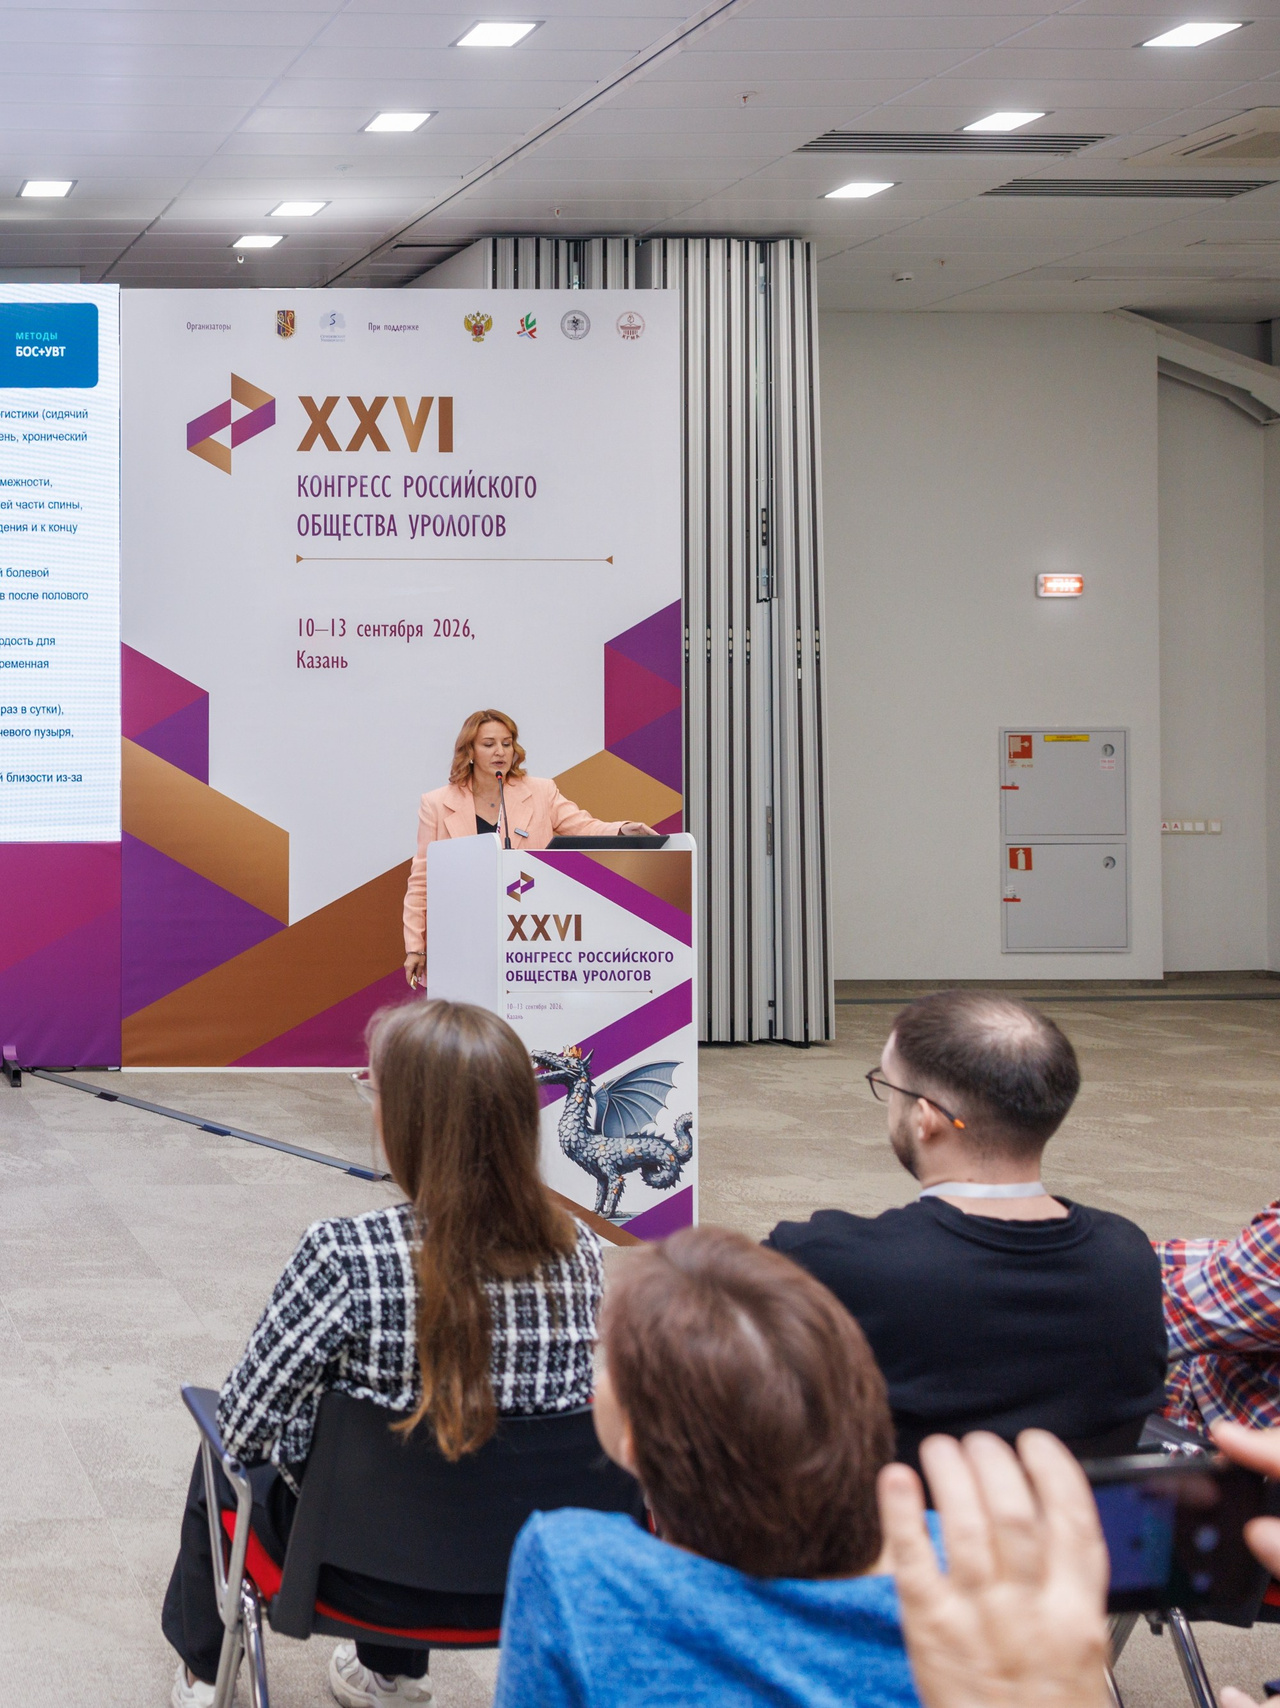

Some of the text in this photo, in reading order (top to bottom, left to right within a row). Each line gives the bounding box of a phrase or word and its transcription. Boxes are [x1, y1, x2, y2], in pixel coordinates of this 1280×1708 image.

[16, 332, 58, 342] МЕТОДЫ
[16, 346, 66, 357] БОС+УВТ
[42, 409, 88, 421] (сидячий
[296, 396, 453, 453] XXVI
[22, 431, 88, 444] хронический
[298, 469, 537, 498] КОНГРЕСС РОССИЙСКОГО
[15, 501, 45, 510] части
[47, 501, 83, 510] спины,
[31, 524, 38, 532] и
[40, 524, 46, 532] к
[48, 524, 78, 535] концу
[297, 514, 506, 541] ОБЩЕСТВА УРОЛОГОВ
[6, 567, 49, 578] болевой
[357, 619, 423, 643] сентября
[433, 618, 475, 640] 2026,
[36, 637, 56, 647] для
[297, 650, 348, 669] Казань
[507, 914, 582, 941] XXVI
[506, 948, 674, 963] КОНГРЕСС РОССИЙСКОГО
[506, 970, 651, 984] ОБЩЕСТВА УРОЛОГОВ
